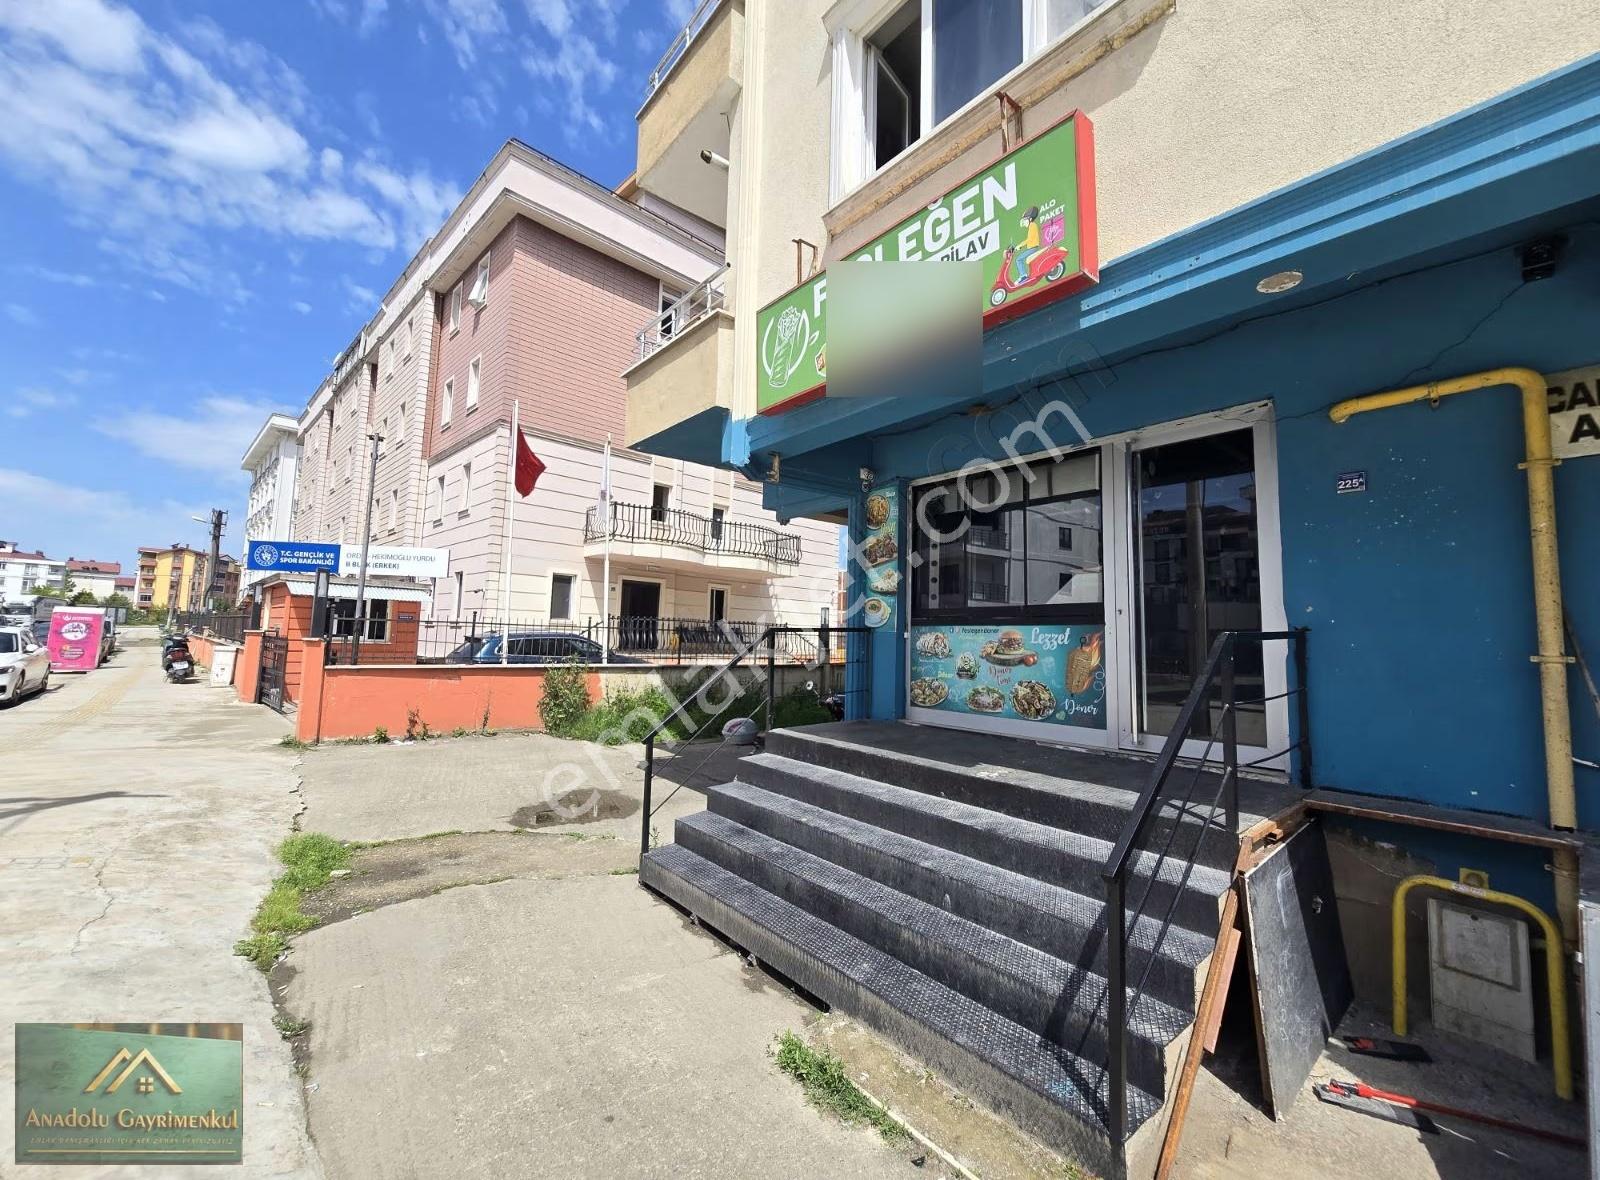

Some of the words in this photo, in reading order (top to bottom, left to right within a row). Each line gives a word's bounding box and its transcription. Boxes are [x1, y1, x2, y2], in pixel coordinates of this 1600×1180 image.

[1040, 199, 1056, 213] ALO
[1040, 204, 1065, 224] PAKET
[1547, 380, 1600, 414] CA
[294, 551, 324, 559] GENÇLİK
[298, 558, 335, 566] BAKANLIĞI
[1031, 627, 1071, 650] Lezzet
